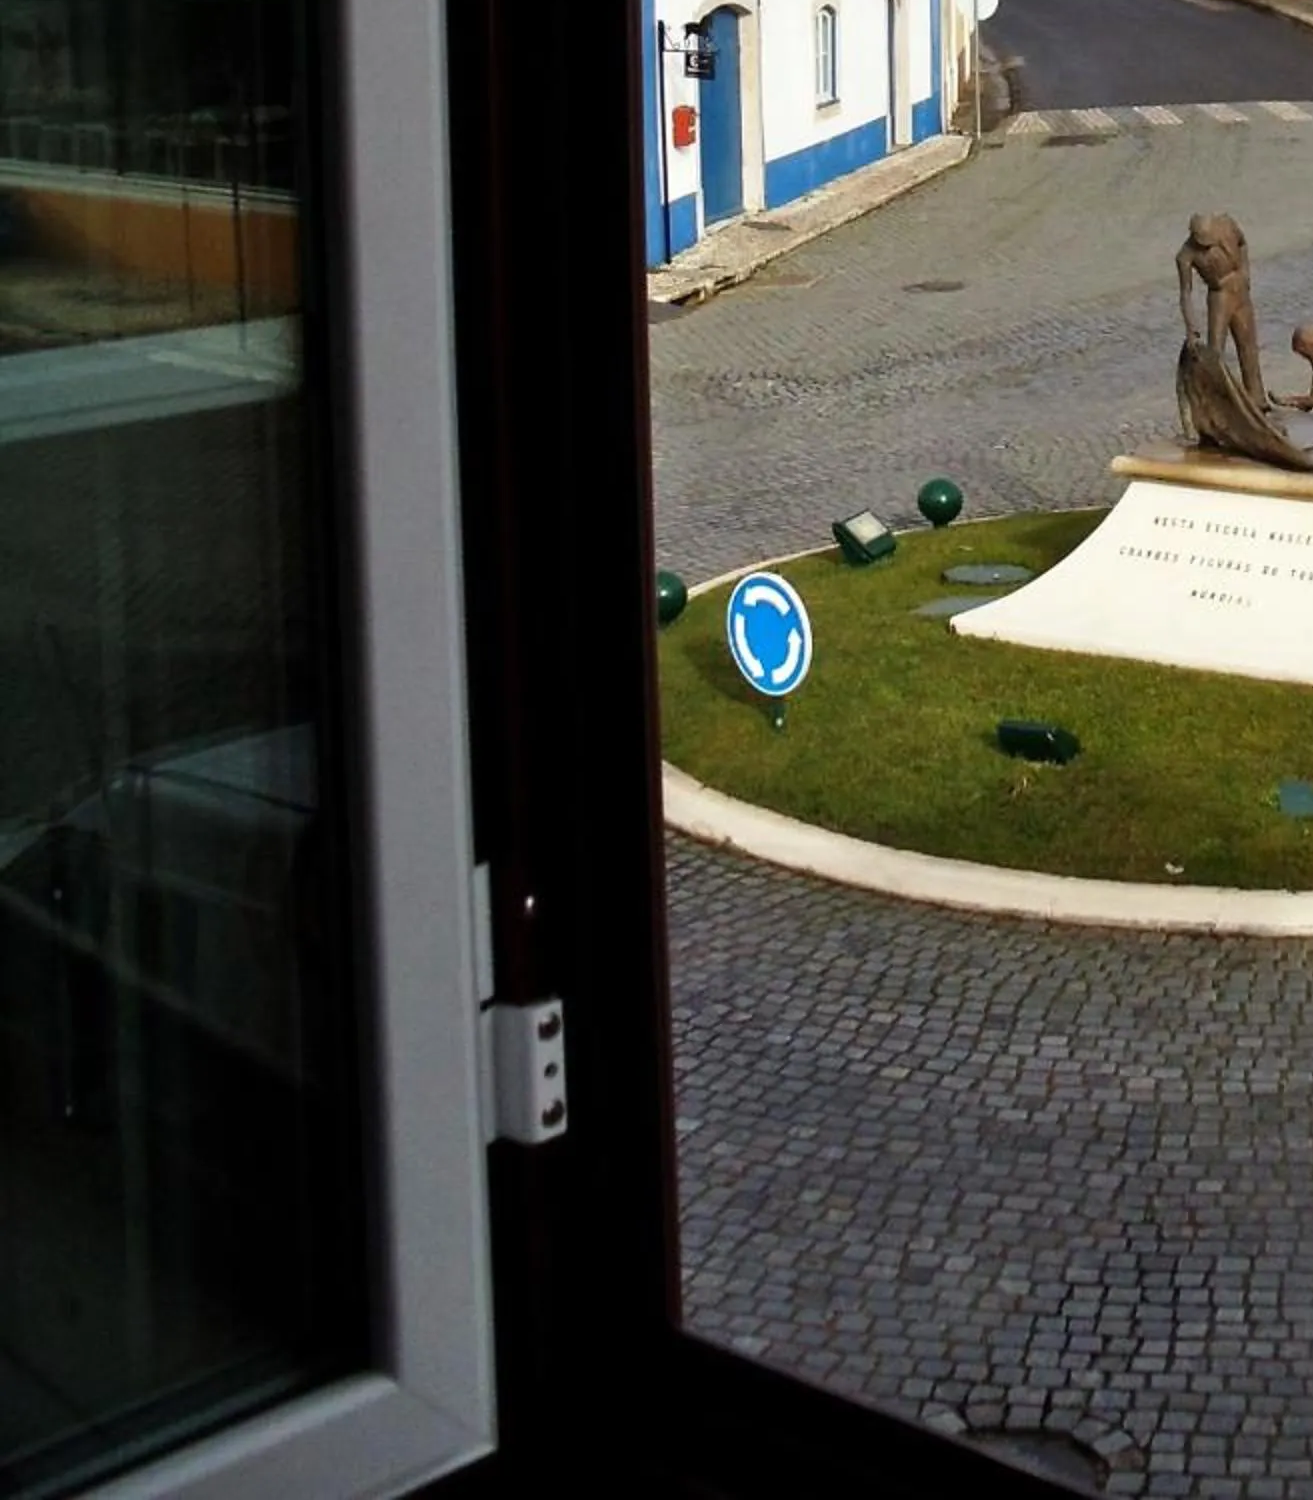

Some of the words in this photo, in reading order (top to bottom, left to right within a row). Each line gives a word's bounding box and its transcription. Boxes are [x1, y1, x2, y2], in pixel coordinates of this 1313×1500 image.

[1153, 515, 1195, 530] NESTA
[1205, 521, 1257, 539] ESCOLA
[1190, 554, 1252, 573] FIGURAS
